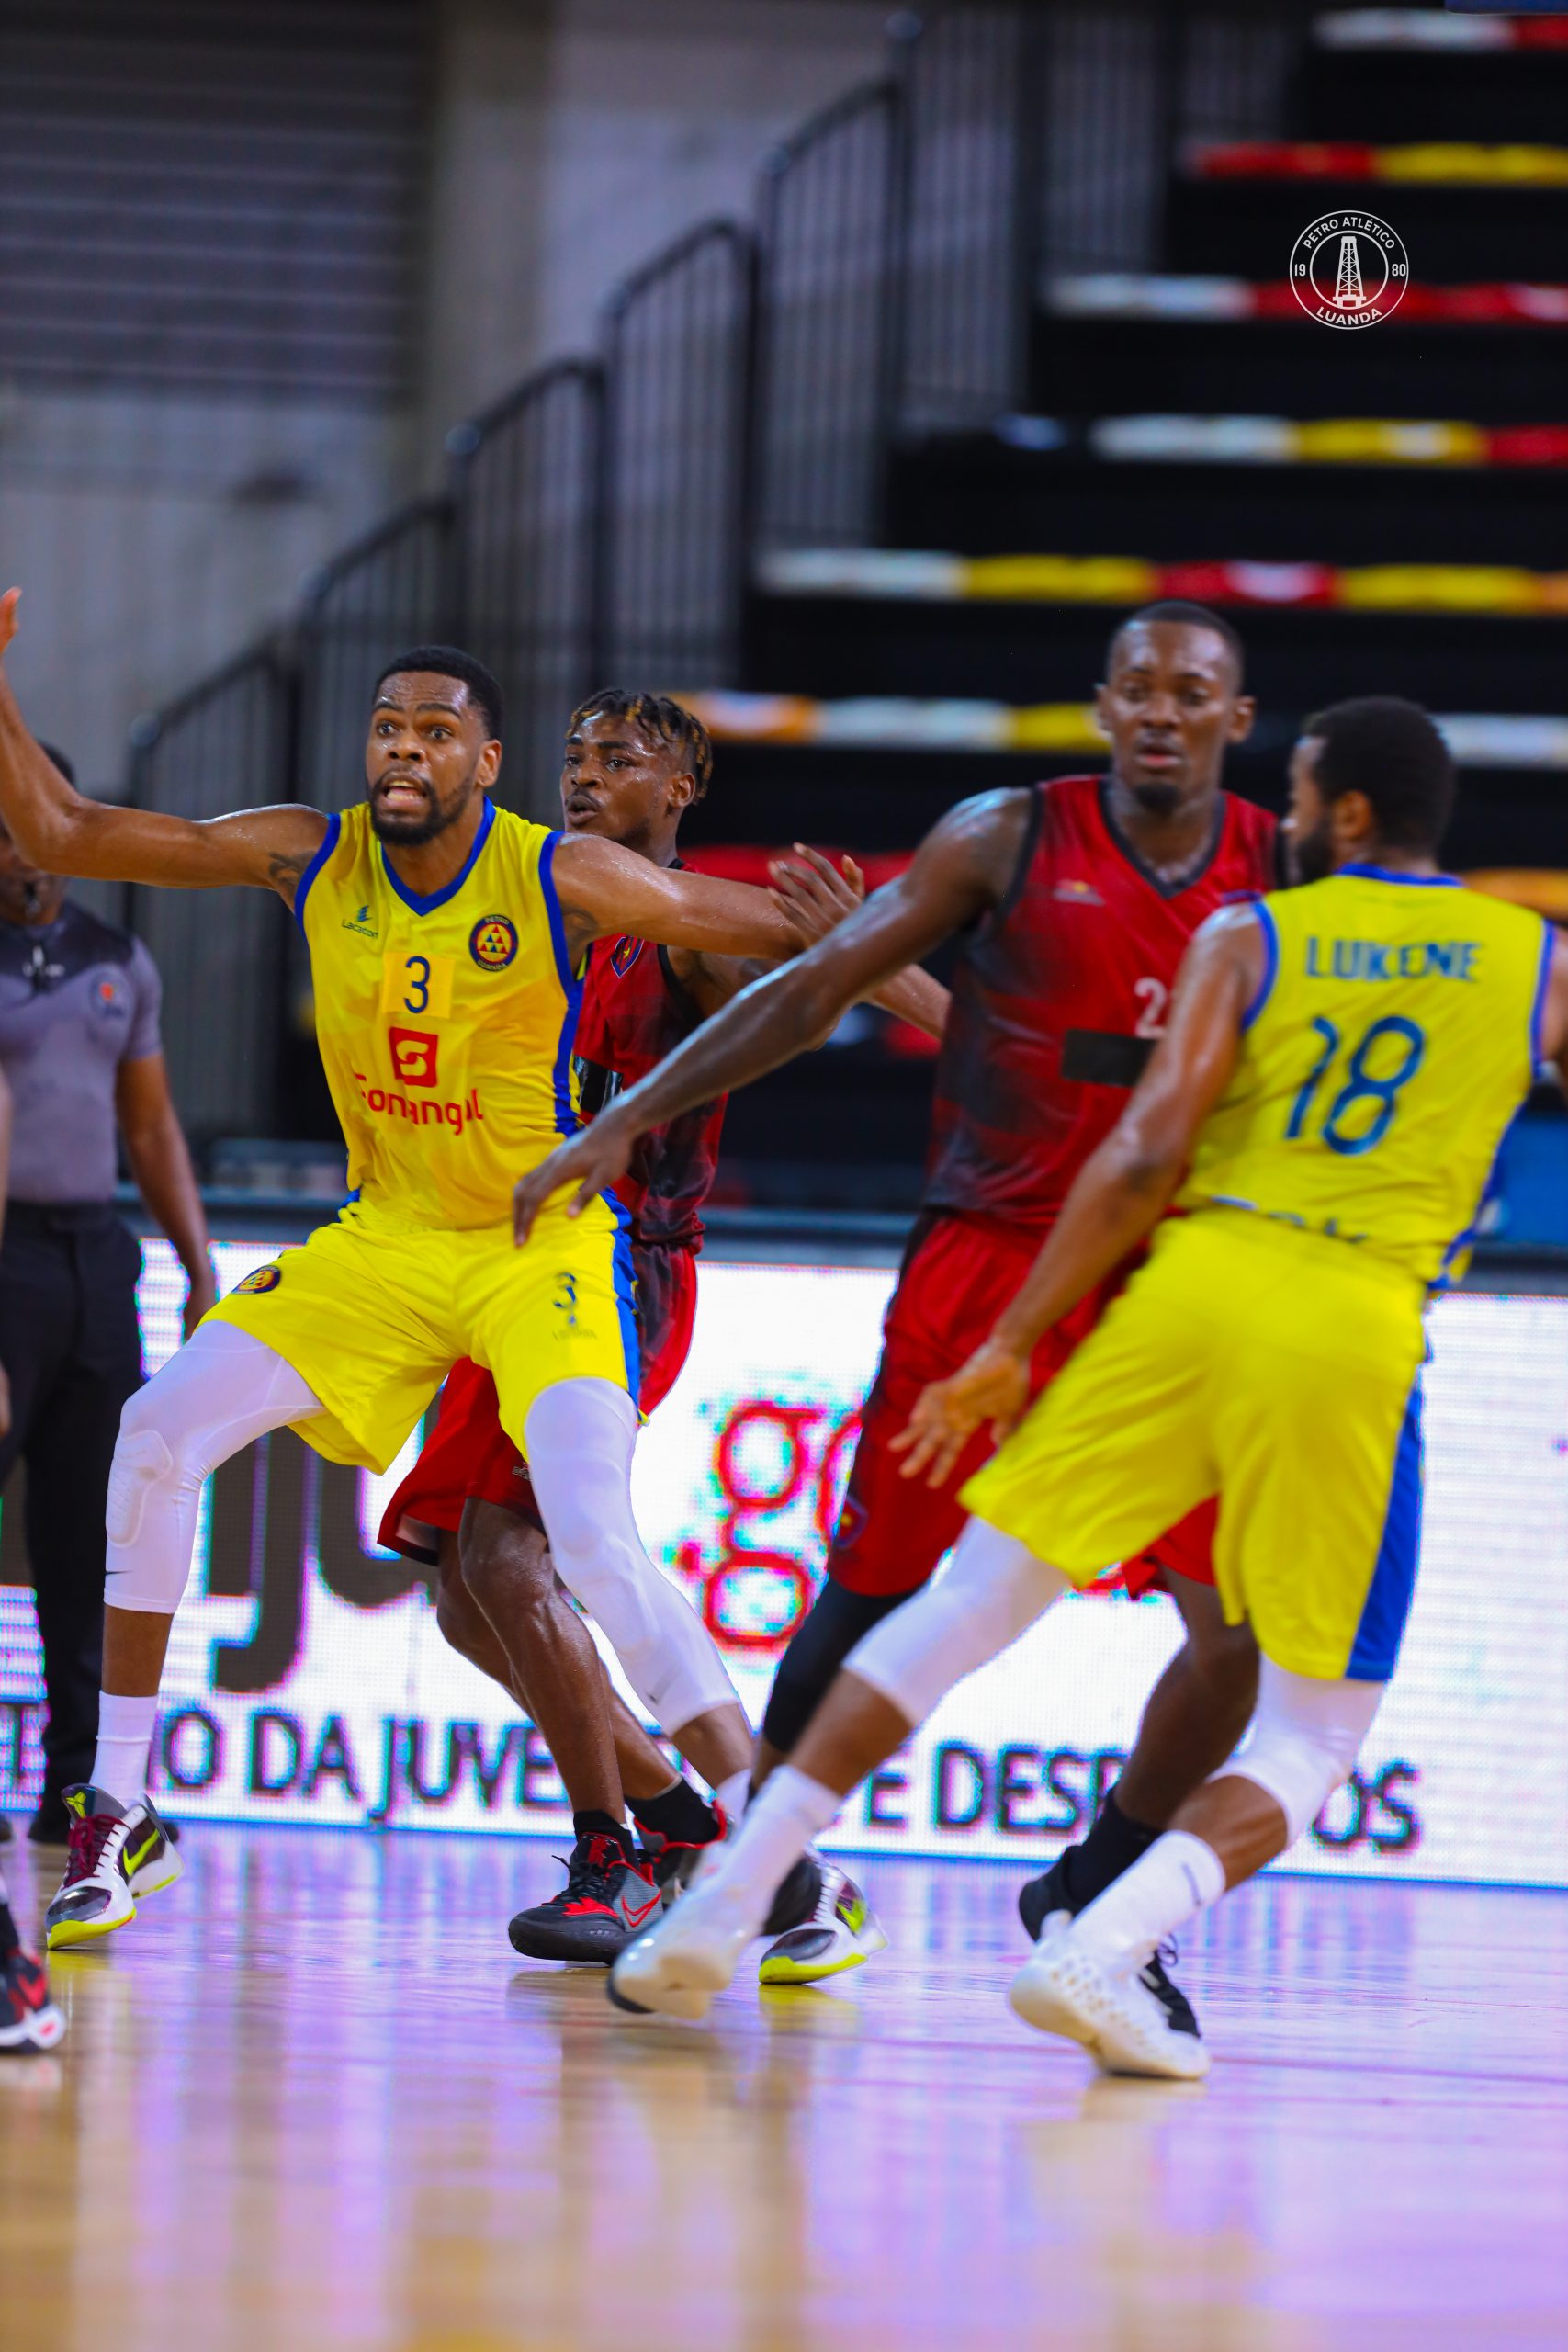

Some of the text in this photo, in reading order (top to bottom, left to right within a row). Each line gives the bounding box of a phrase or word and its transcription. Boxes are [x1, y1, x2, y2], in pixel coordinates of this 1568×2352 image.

[403, 956, 431, 1014] 3
[1304, 936, 1483, 983] LUKENE
[1283, 1014, 1426, 1157] 18
[553, 1272, 577, 1312] 3
[248, 1709, 362, 1799] DA
